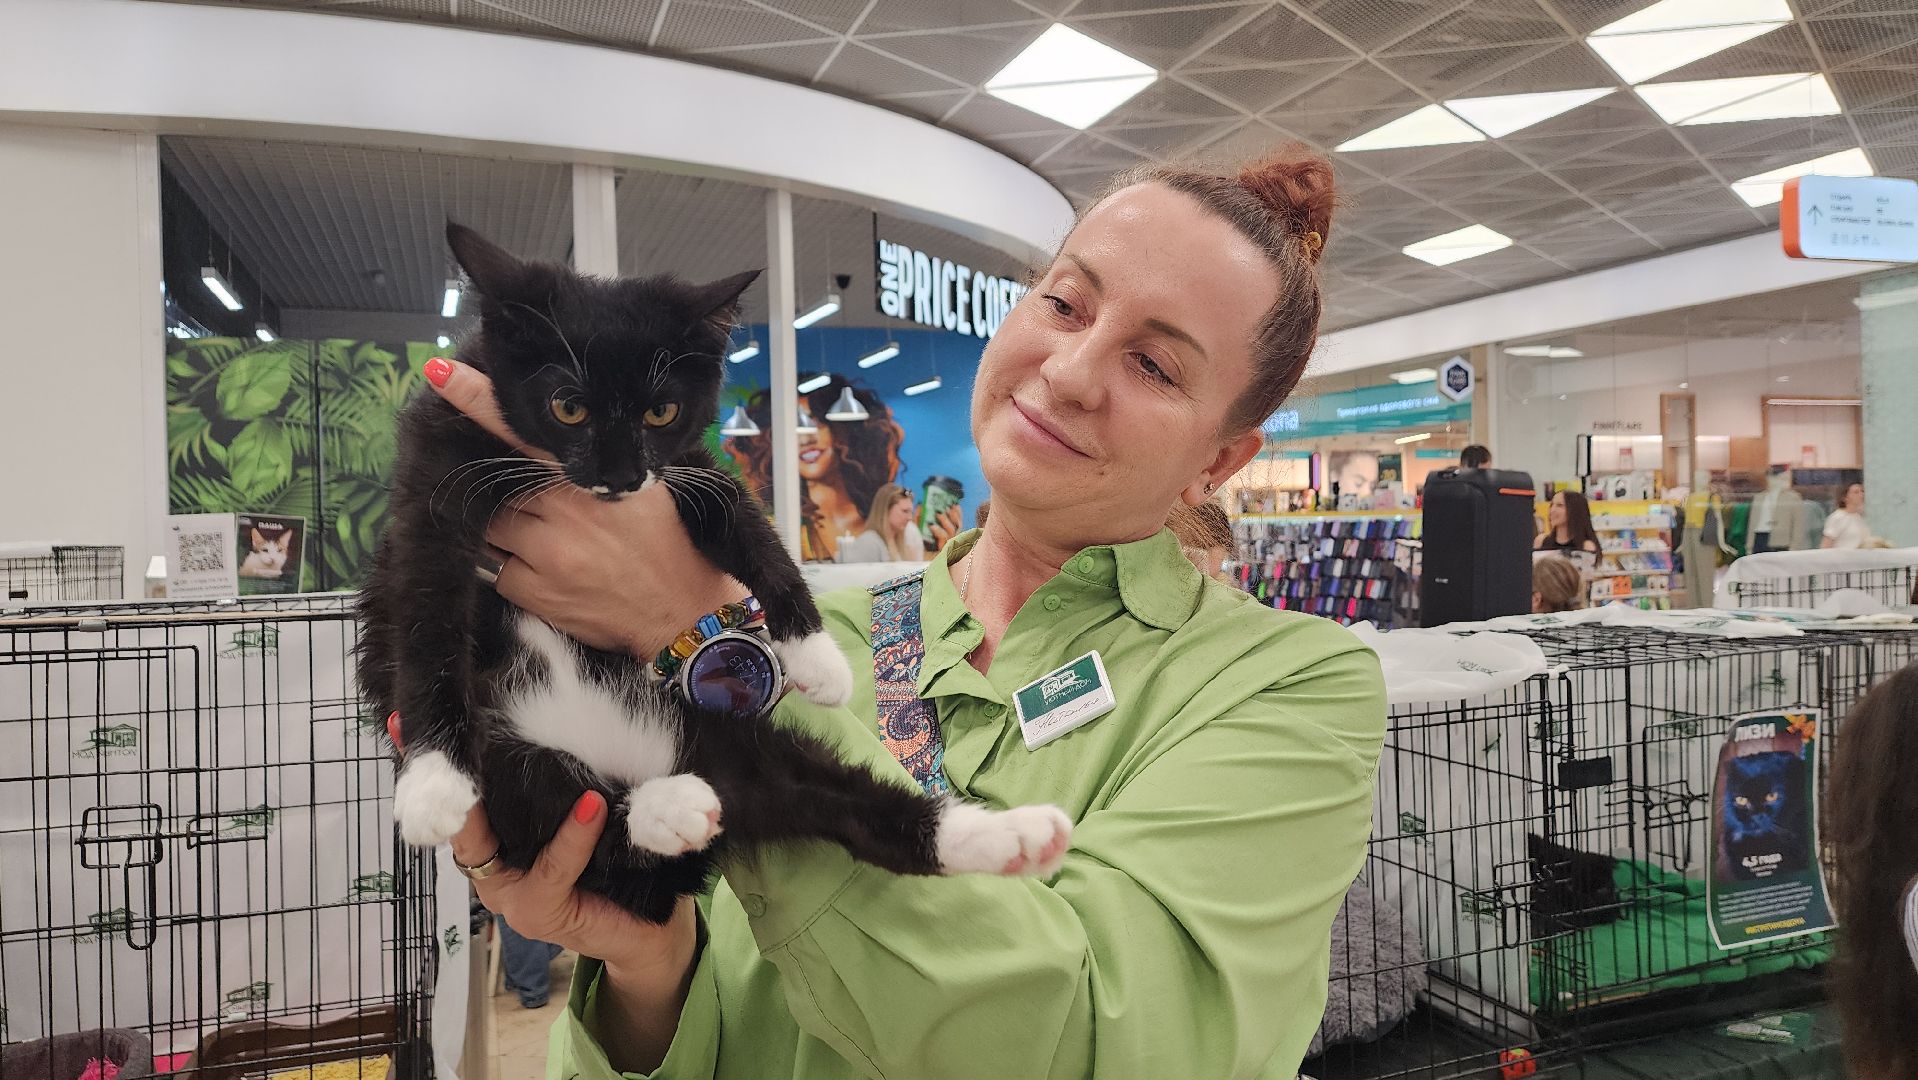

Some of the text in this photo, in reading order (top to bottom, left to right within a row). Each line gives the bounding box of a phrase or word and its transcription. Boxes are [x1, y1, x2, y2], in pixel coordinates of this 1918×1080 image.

[879, 239, 899, 317] ONE
[897, 244, 972, 336] PRICE
[1734, 722, 1776, 743] ЛИЗИ
